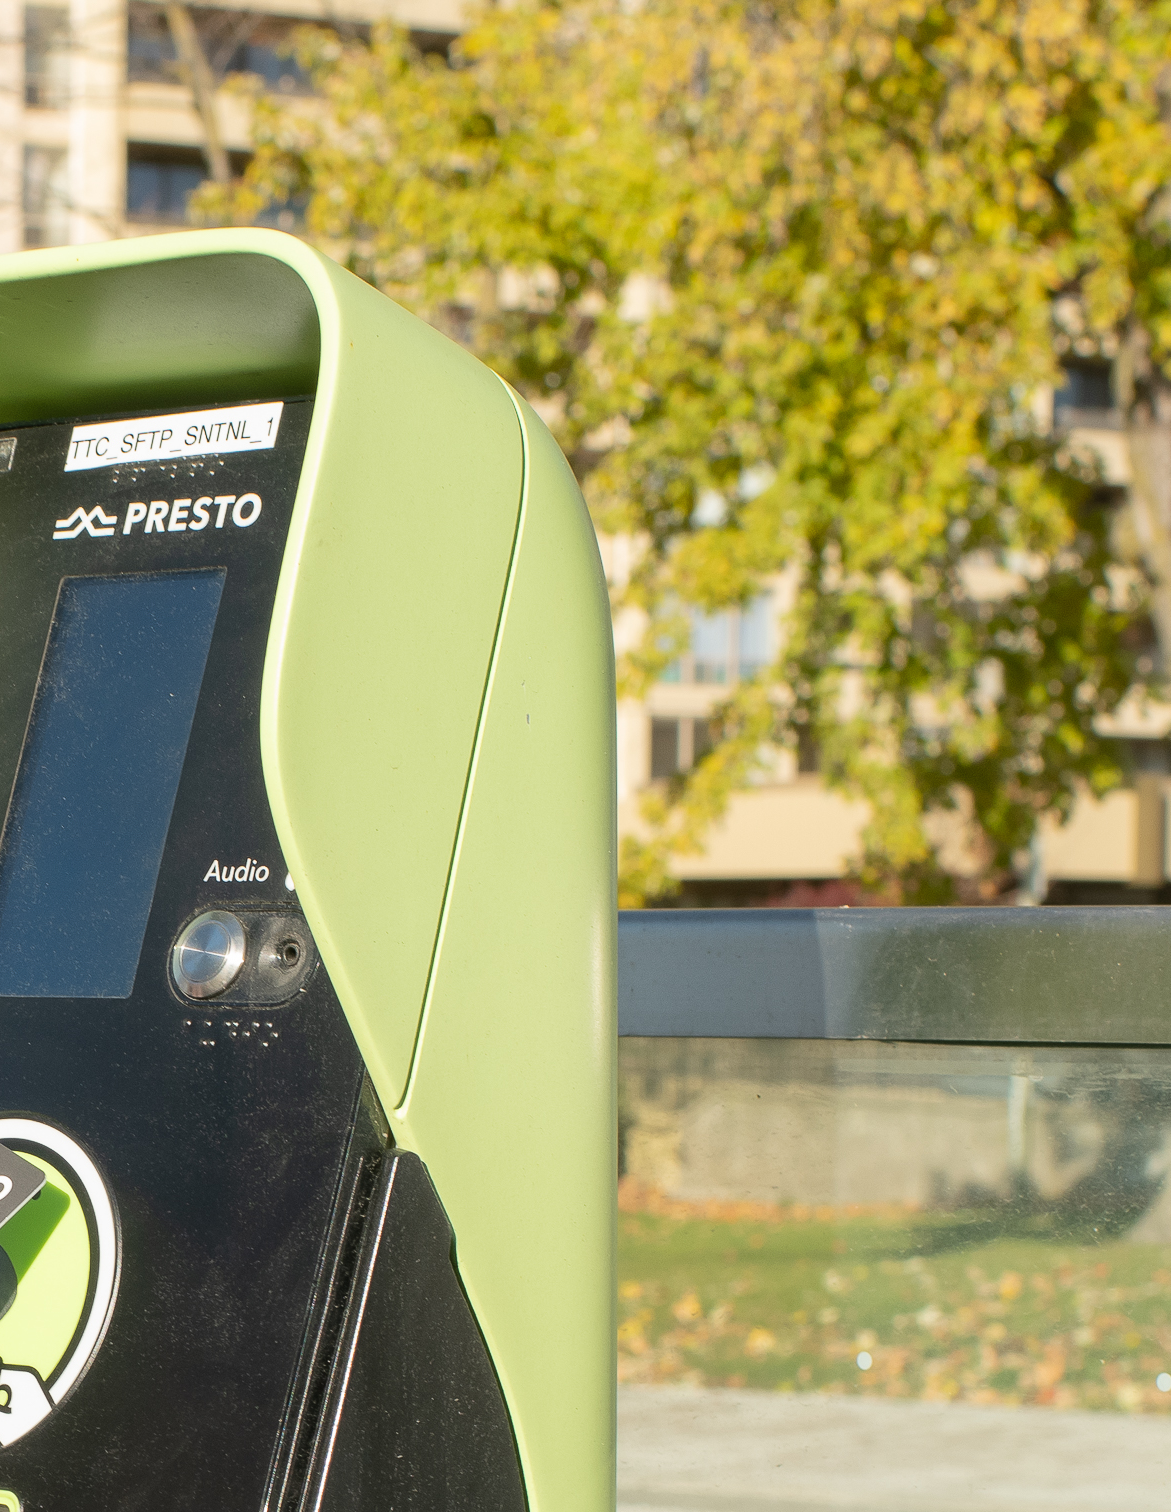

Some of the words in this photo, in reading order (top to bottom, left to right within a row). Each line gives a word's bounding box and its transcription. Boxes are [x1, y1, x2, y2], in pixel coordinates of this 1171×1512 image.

[71, 417, 275, 461] TTC_SFTP_SNTNL_1
[123, 493, 262, 535] PRESTO
[203, 857, 270, 884] Audio
